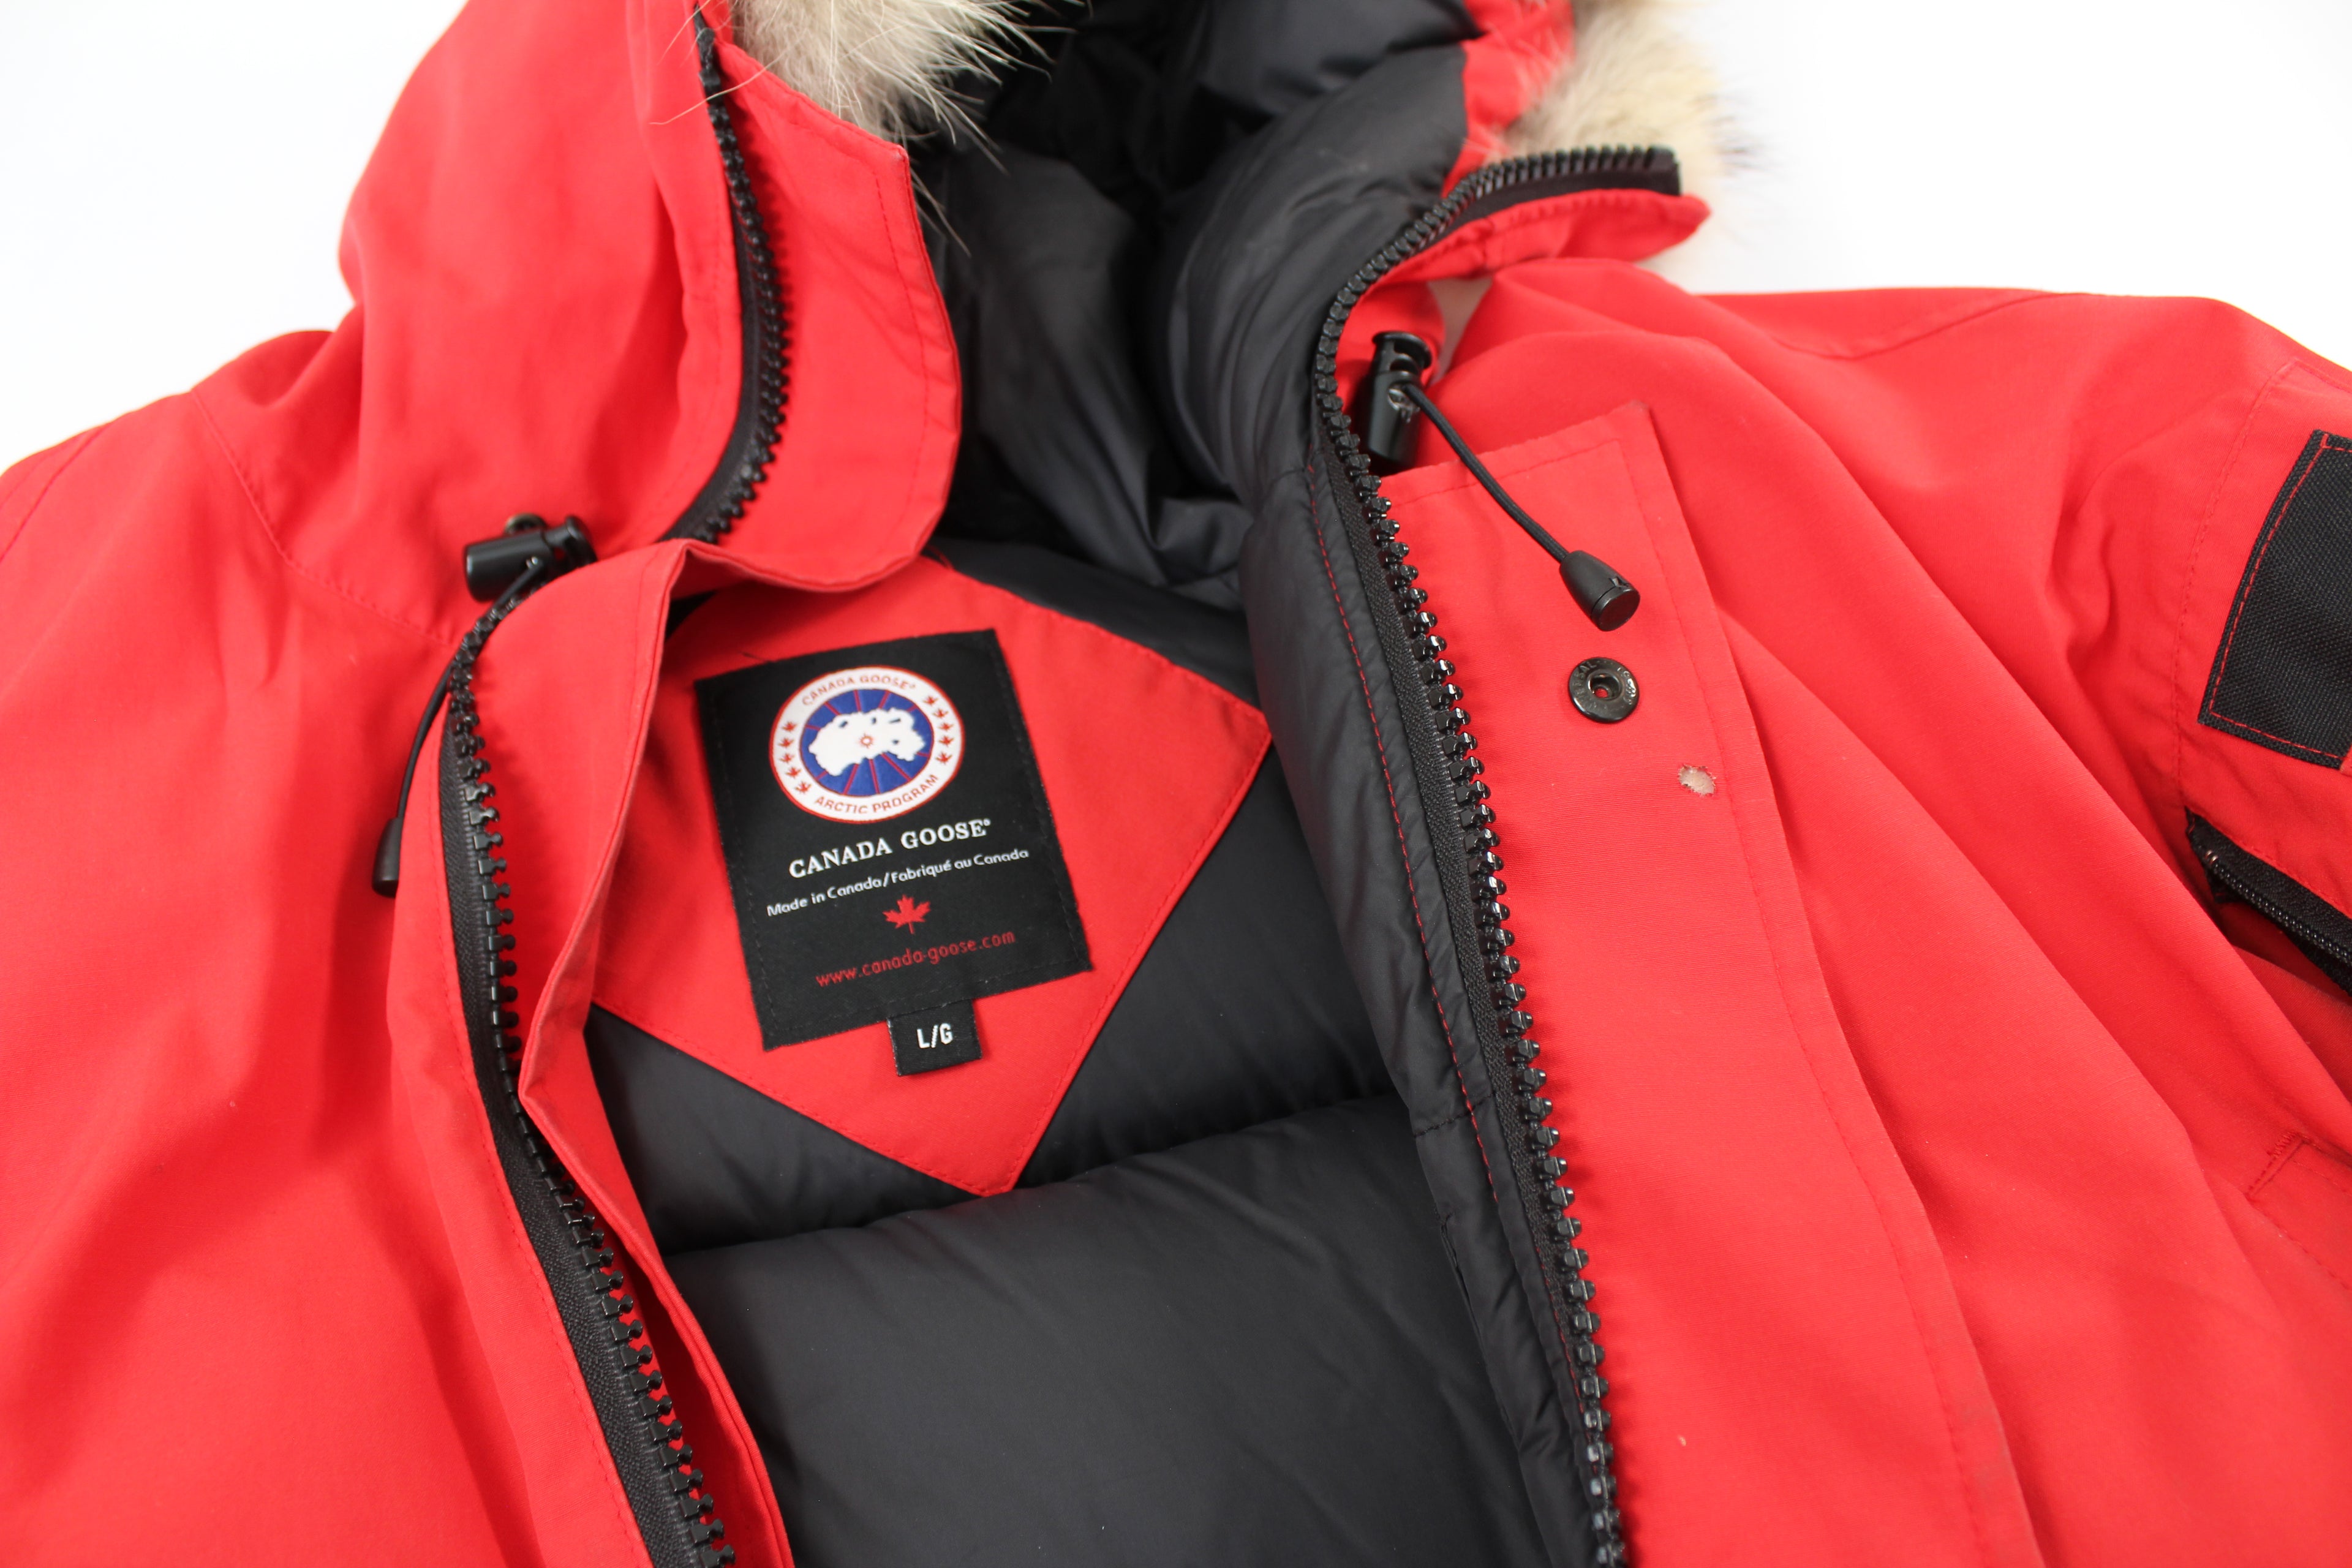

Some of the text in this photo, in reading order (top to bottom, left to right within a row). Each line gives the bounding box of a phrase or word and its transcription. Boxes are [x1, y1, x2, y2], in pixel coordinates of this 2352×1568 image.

[802, 676, 855, 706] CANADA
[814, 774, 938, 814] ARCTIC PROGRAM
[788, 837, 894, 878] CANADA
[766, 898, 808, 917] Made
[811, 892, 826, 904] in
[954, 859, 972, 869] au
[973, 848, 1029, 865] Canada
[815, 931, 1016, 987] www.canada-goose.com
[917, 1022, 953, 1049] L/G
